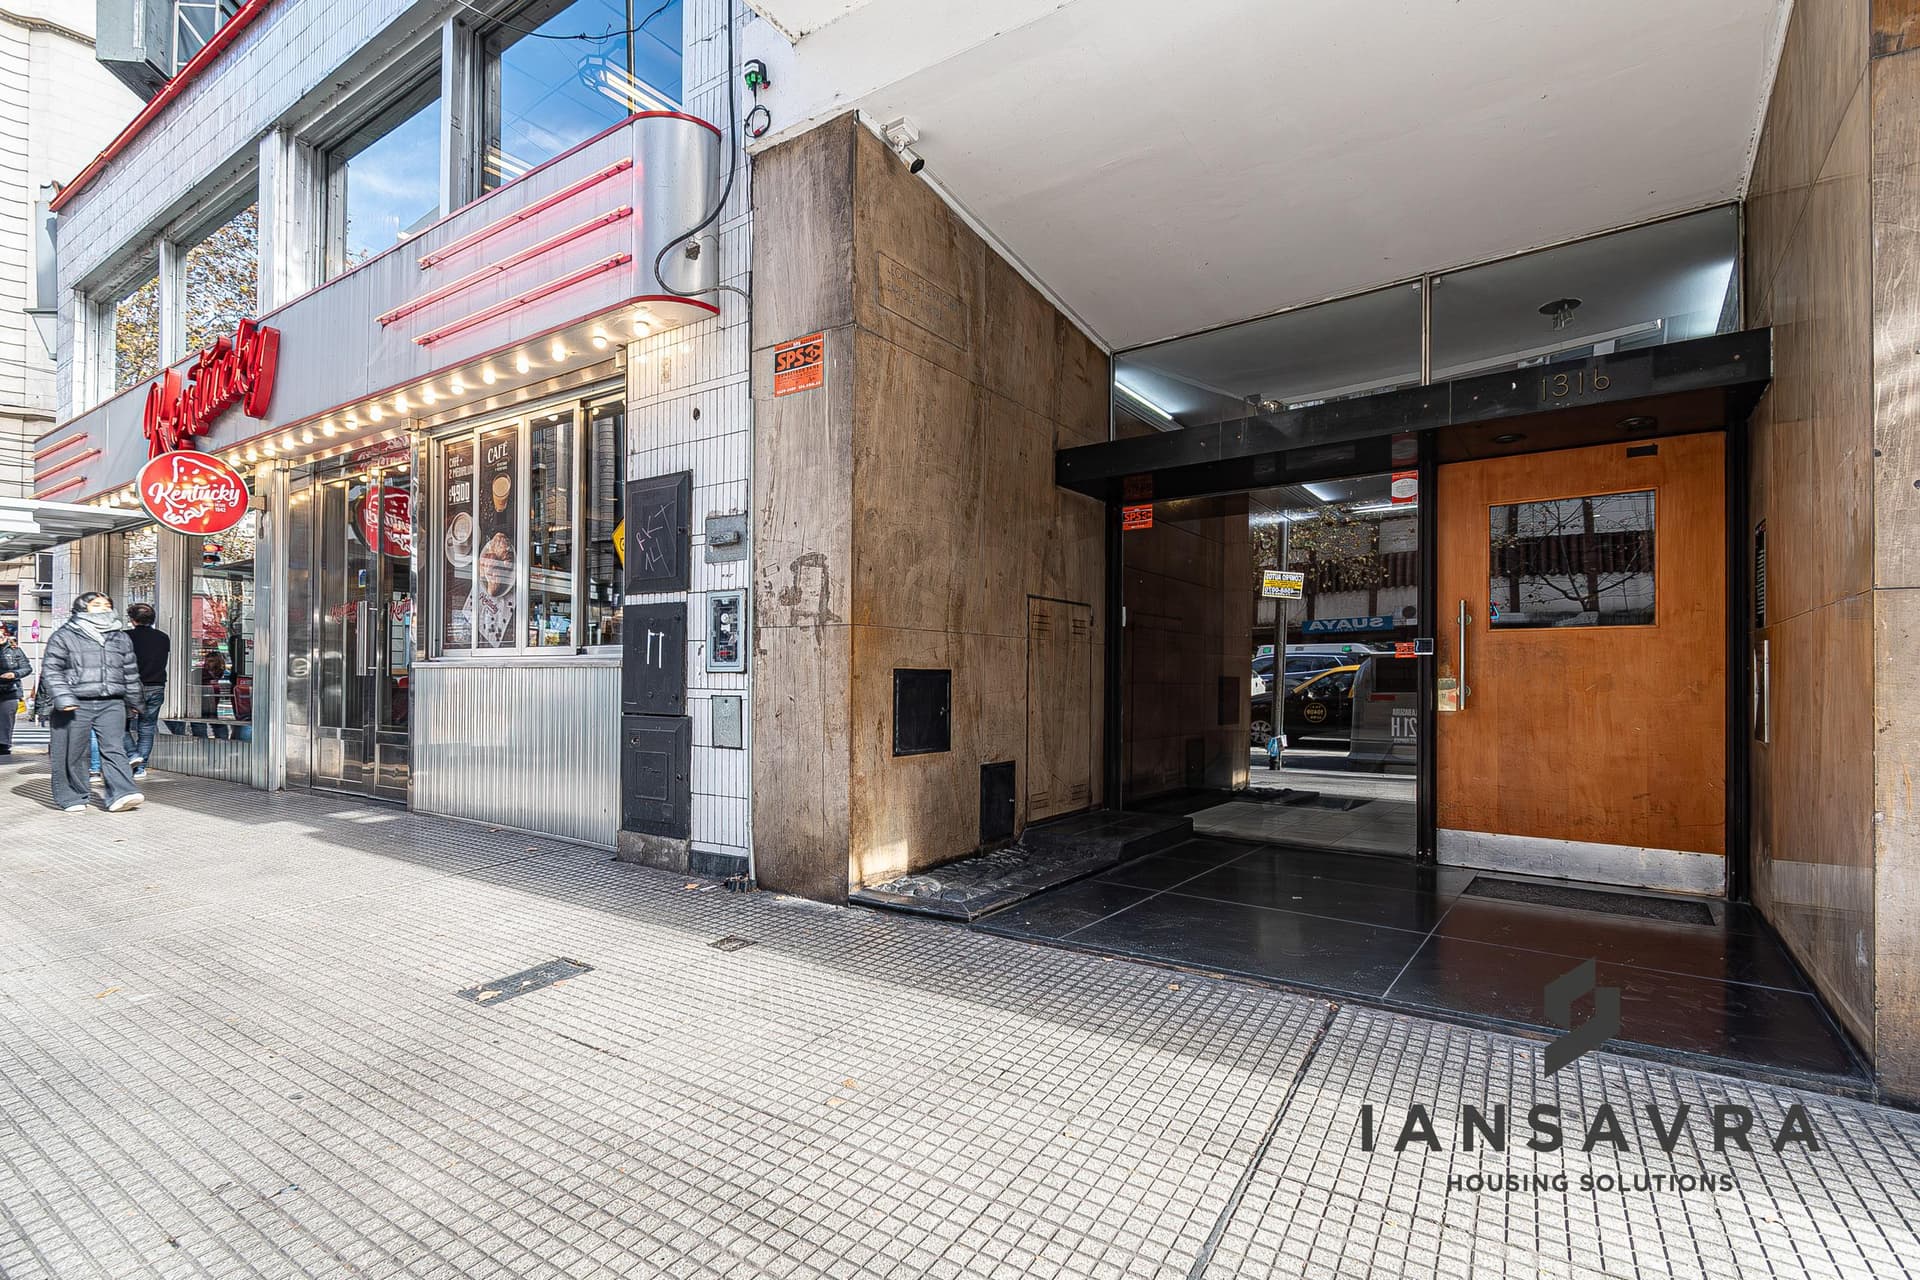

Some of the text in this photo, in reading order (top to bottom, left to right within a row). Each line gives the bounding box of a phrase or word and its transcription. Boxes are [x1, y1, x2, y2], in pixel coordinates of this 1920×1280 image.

[1542, 367, 1610, 401] 1316
[487, 440, 509, 464] CAFÉ
[147, 481, 241, 509] Kentucky
